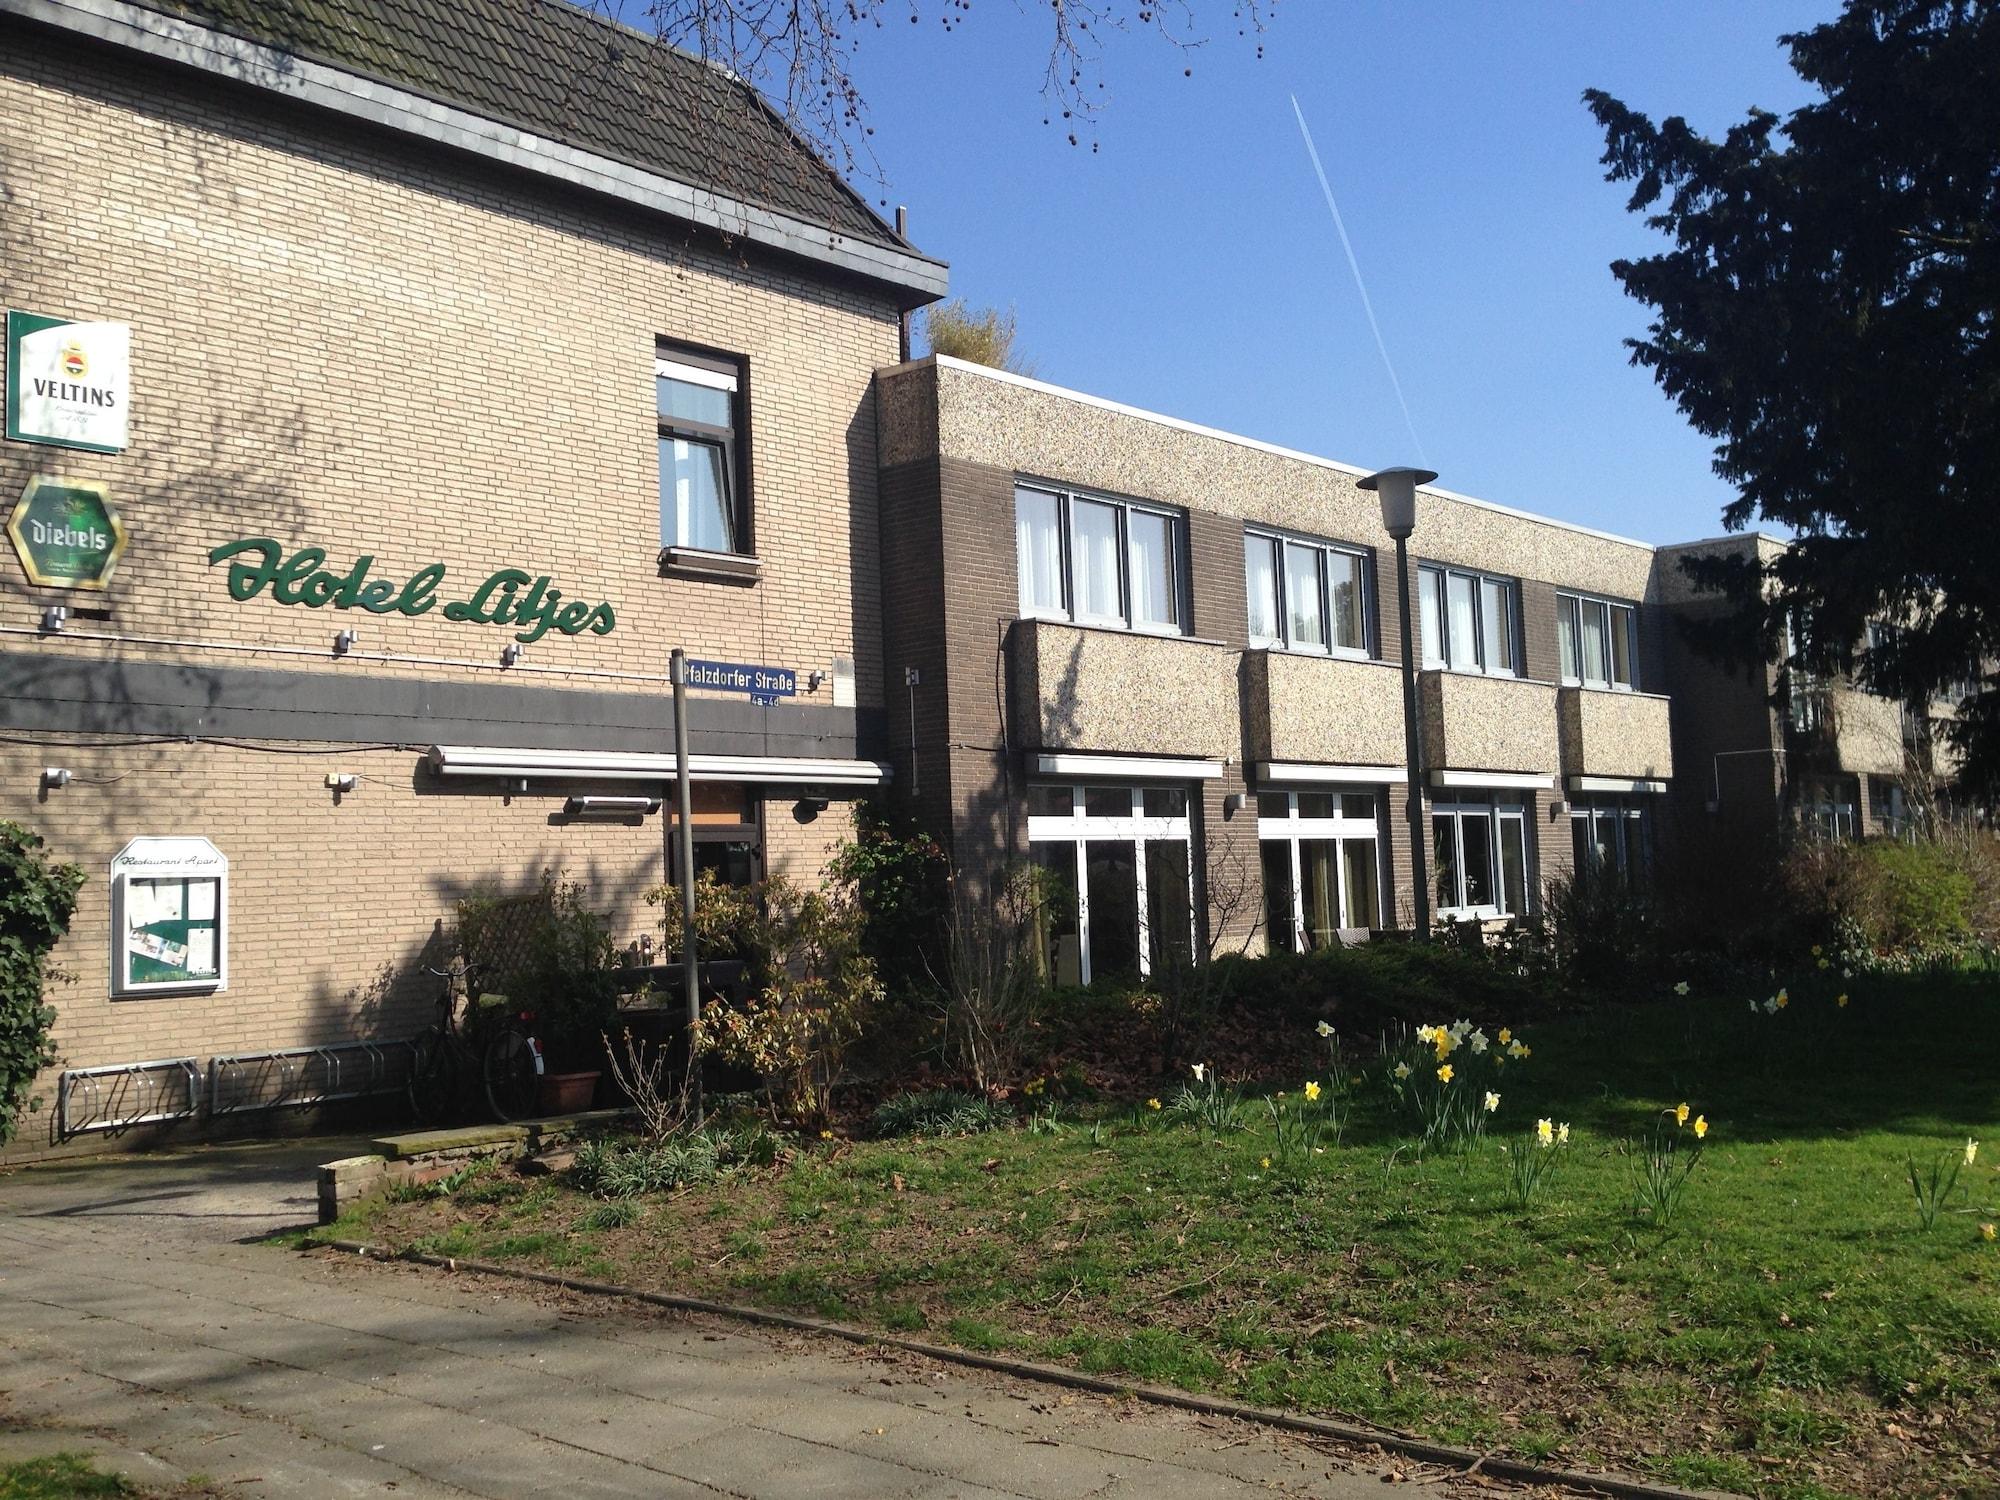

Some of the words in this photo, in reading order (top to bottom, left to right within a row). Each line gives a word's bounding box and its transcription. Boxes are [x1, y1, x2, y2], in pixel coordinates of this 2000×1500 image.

[34, 378, 115, 408] VELTINS
[31, 519, 107, 551] Diebels
[209, 538, 446, 616] Hotel
[443, 568, 616, 643] Litjes
[755, 672, 793, 691] Straße
[120, 856, 181, 866] Restaurant
